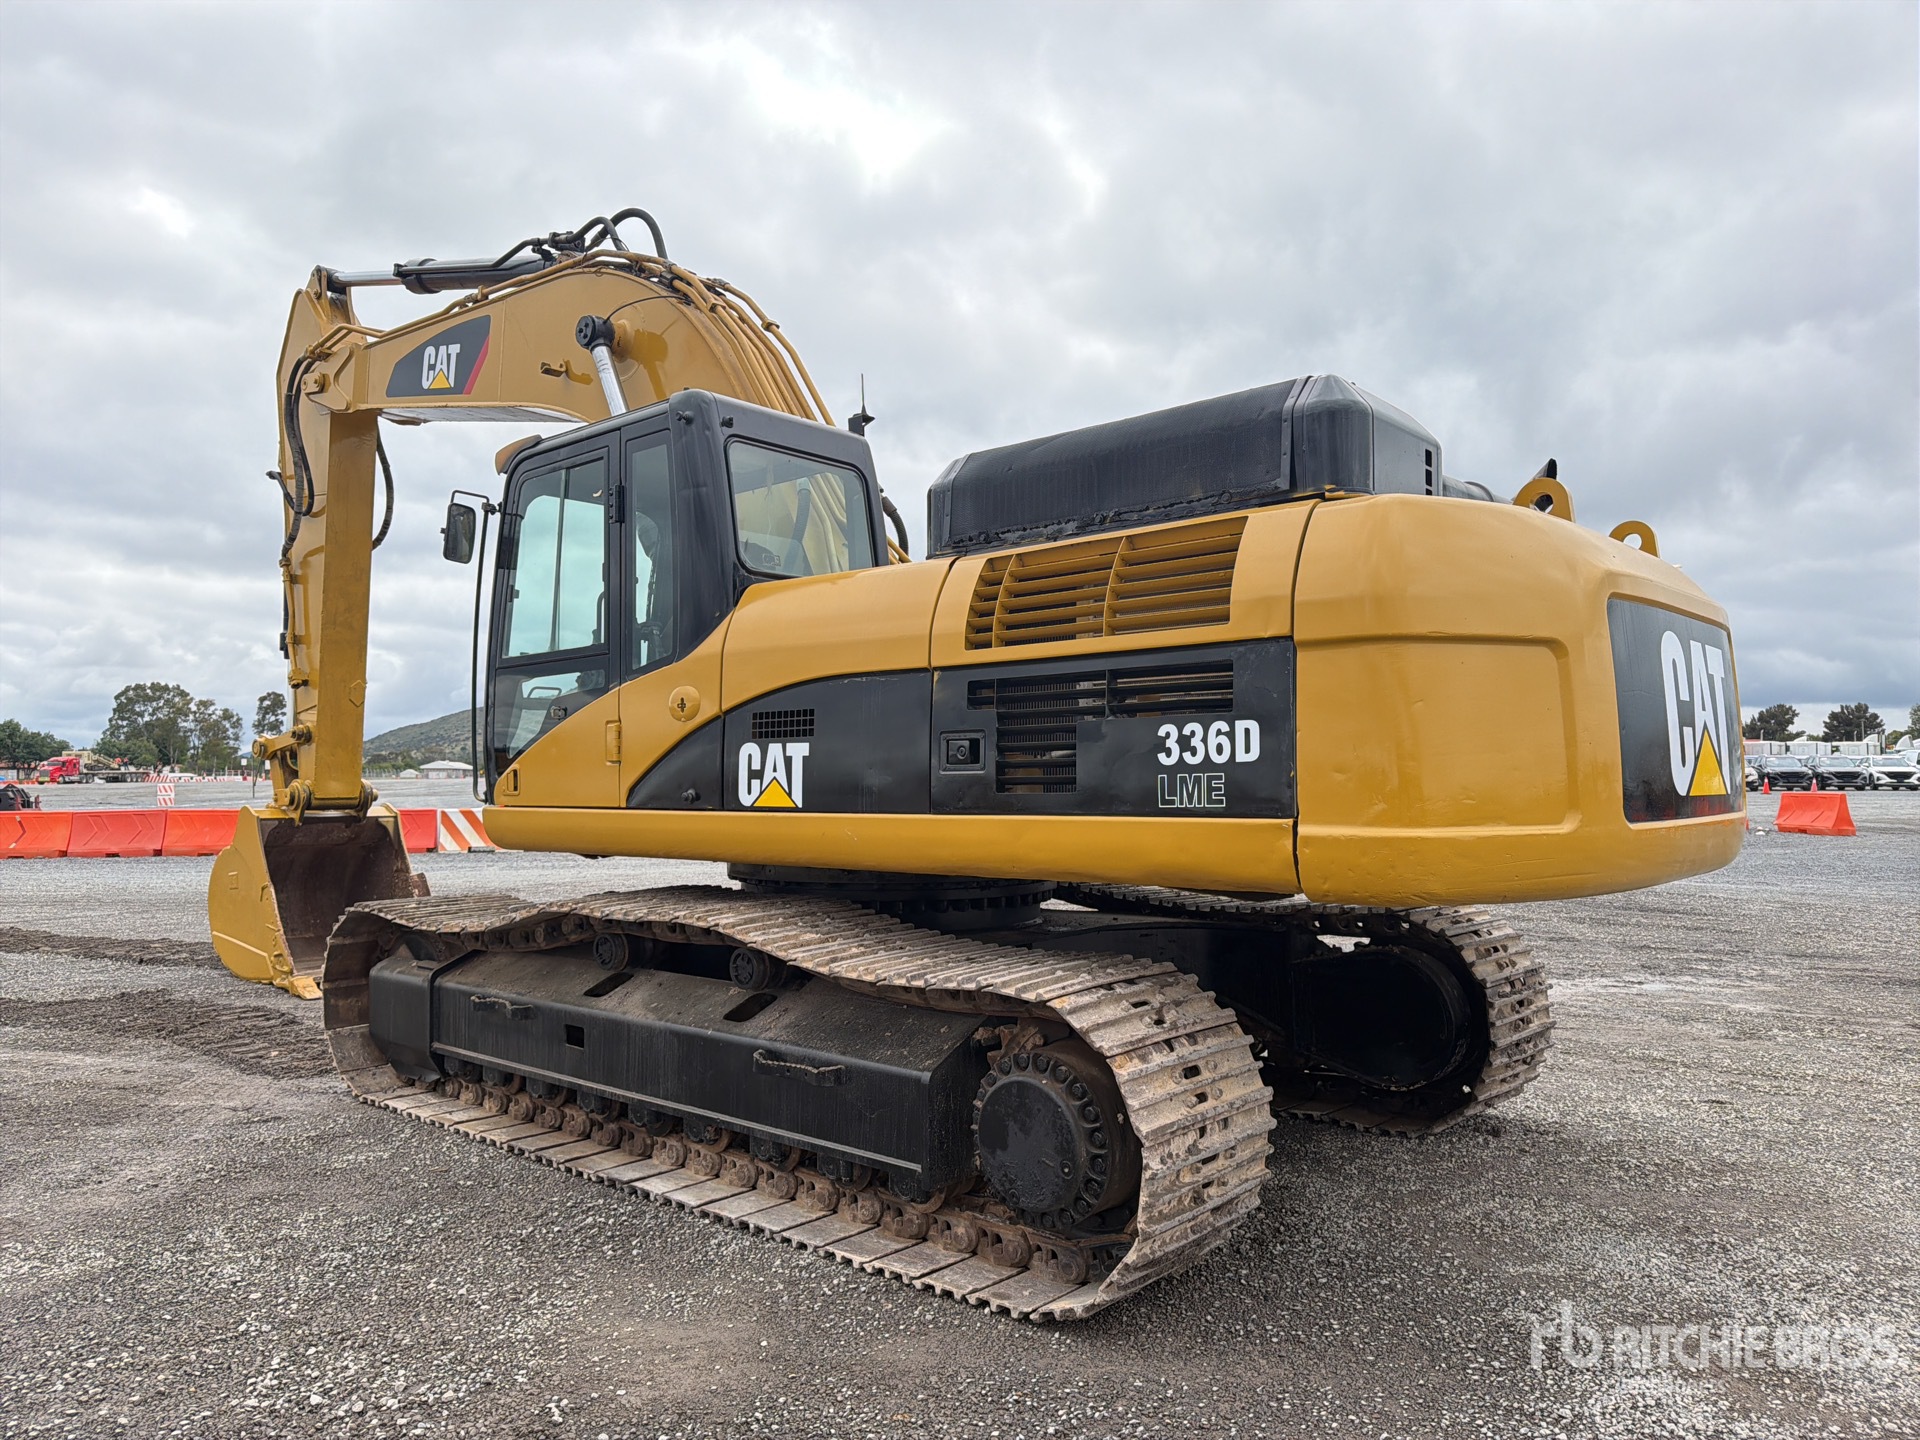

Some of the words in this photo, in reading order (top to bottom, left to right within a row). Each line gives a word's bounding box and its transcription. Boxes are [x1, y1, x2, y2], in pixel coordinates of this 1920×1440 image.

[421, 343, 461, 390] CAT
[1662, 630, 1730, 797] CAT
[1157, 719, 1261, 766] 336D
[738, 742, 810, 808] CAT
[1158, 774, 1226, 808] LME
